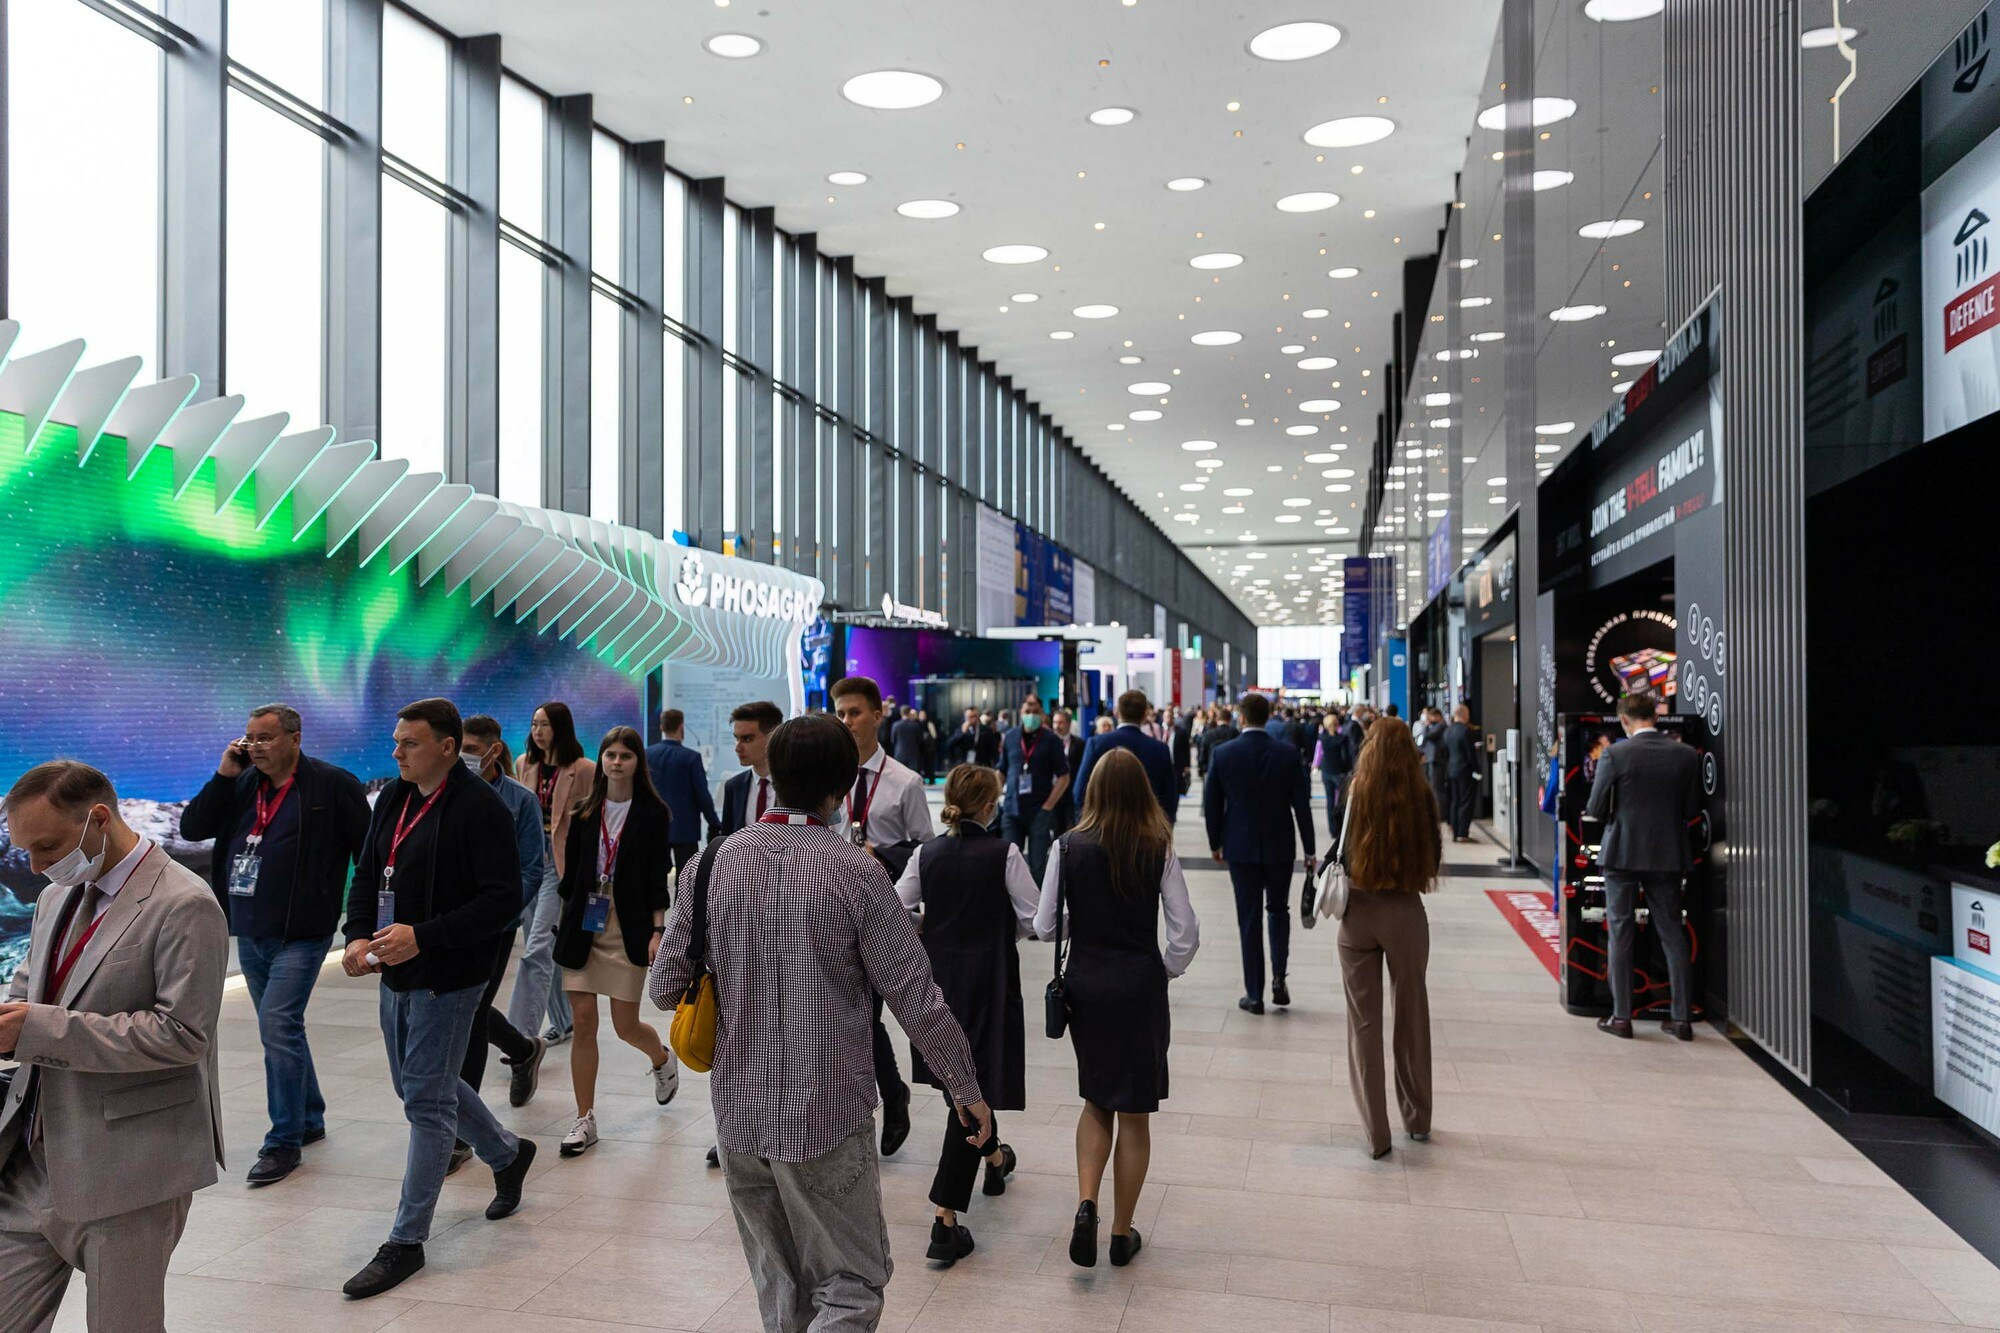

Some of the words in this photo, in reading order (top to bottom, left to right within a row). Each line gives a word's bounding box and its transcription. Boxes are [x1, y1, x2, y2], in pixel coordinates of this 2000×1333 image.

[1949, 284, 1995, 336] DEFENCE
[1590, 500, 1610, 538] JOIN
[1609, 487, 1627, 525] THE
[1658, 429, 1704, 494] FAMILY!
[709, 571, 817, 626] PHOSAGRO
